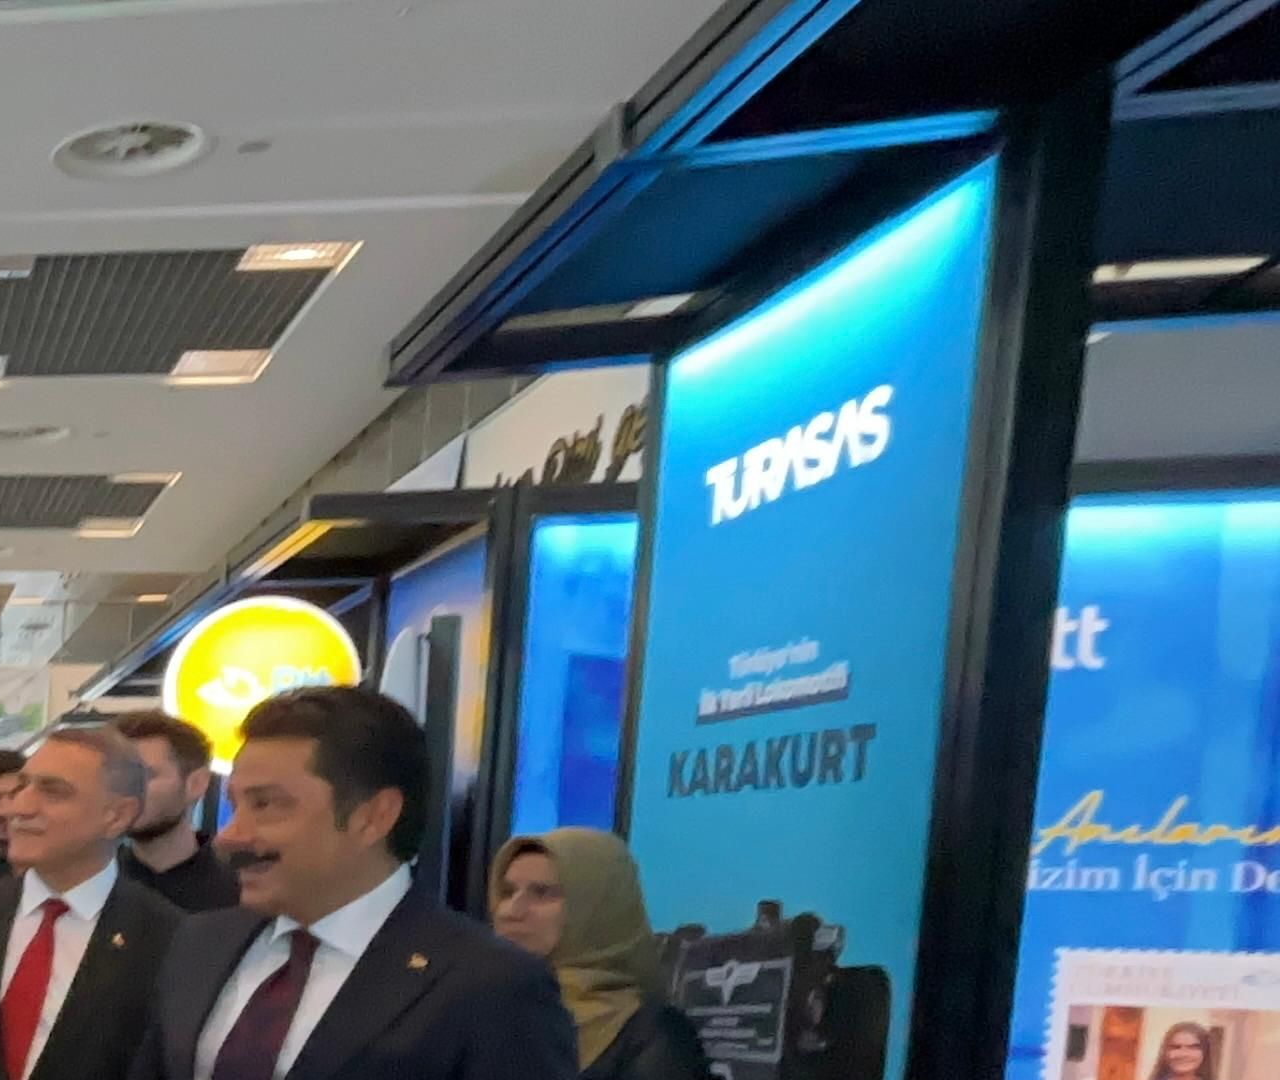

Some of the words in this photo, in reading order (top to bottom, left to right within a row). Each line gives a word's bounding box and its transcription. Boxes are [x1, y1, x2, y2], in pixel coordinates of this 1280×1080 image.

[1049, 606, 1109, 670] tt
[667, 723, 877, 798] KARAKURT
[1028, 857, 1121, 891] izim
